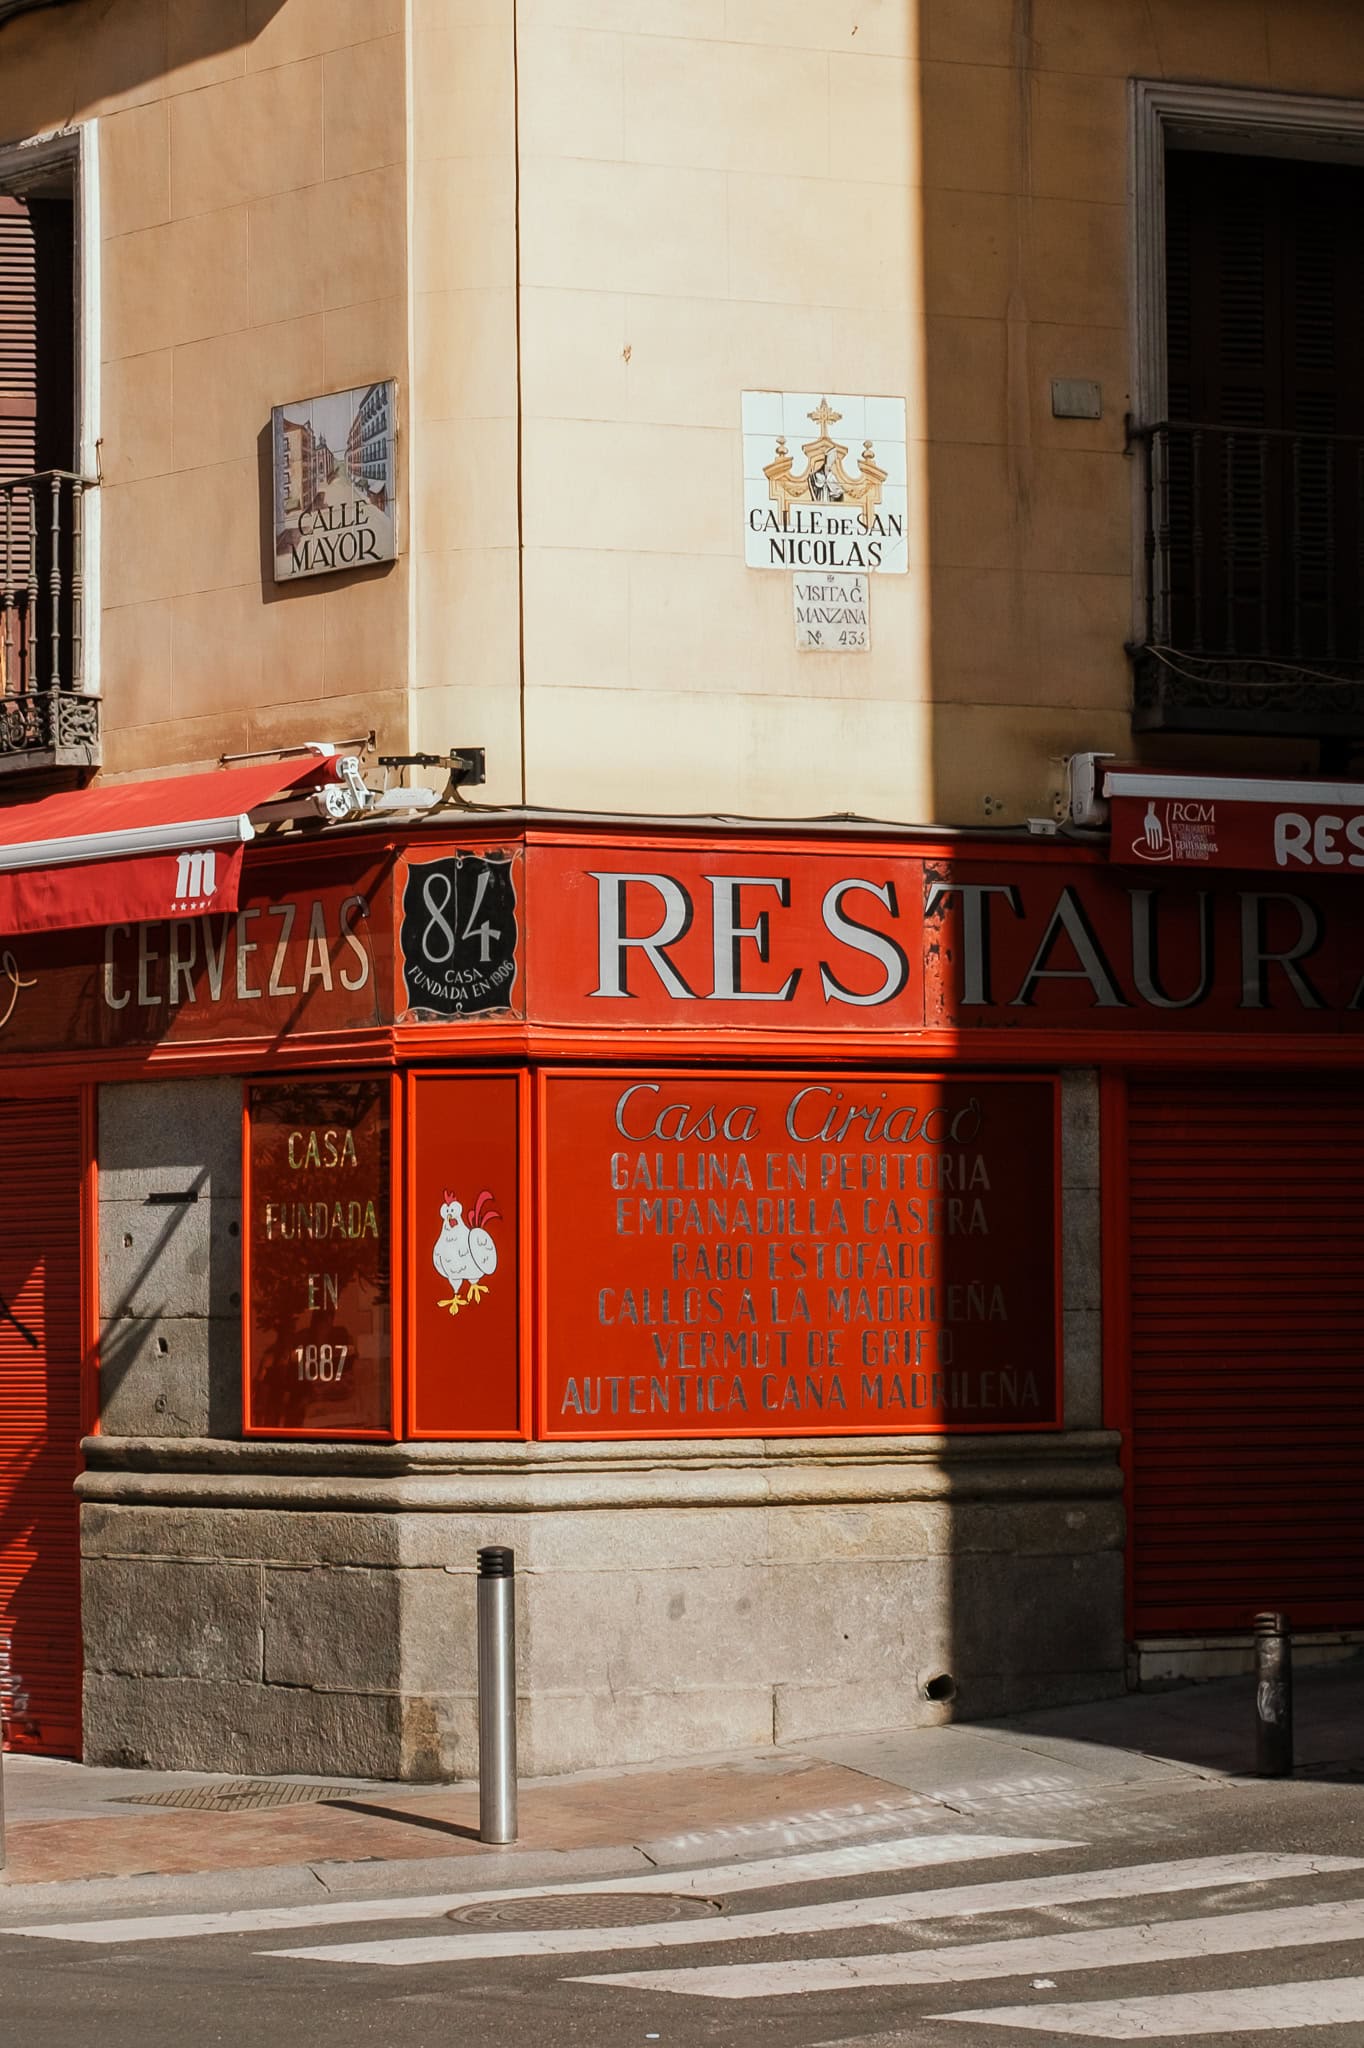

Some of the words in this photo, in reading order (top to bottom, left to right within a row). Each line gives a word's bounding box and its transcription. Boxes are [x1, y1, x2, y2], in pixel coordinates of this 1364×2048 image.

[298, 499, 370, 537] CALLE
[749, 508, 823, 535] CALLE
[827, 517, 853, 536] DE
[856, 512, 903, 537] SAN
[290, 528, 384, 574] MAYOR
[768, 537, 883, 567] NICOLAS
[795, 584, 848, 603] VISITA
[796, 607, 867, 625] MANZANA
[1172, 802, 1216, 822] RCM
[422, 870, 502, 963] 84
[103, 895, 370, 1010] CERVEZAS
[583, 870, 1364, 1010] RESTAUR
[407, 964, 469, 1000] FUNDADA
[471, 982, 491, 998] EN
[444, 967, 484, 985] CASA
[615, 1083, 760, 1142] Casa
[785, 1085, 982, 1144] Ciriaco
[287, 1129, 358, 1170] CASA
[610, 1152, 754, 1191] GALLINA
[766, 1152, 807, 1191] EN
[821, 1152, 991, 1191] PEPITORIA
[265, 1200, 379, 1240] FUNDADA
[616, 1197, 848, 1235] EMPANADILLA
[863, 1197, 989, 1235] CASERA
[671, 1242, 753, 1280] RABO
[768, 1242, 936, 1280] ESTOFADO
[308, 1272, 339, 1311] EN
[598, 1287, 725, 1326] CALLOS
[737, 1287, 758, 1324] A
[771, 1287, 812, 1324] LA
[827, 1280, 1009, 1323] MADRILEÑA
[295, 1343, 348, 1382] 1887
[652, 1330, 793, 1369] VERMUT
[807, 1330, 845, 1367] DE
[861, 1329, 954, 1367] GRIFO
[561, 1374, 749, 1415] AUTENTICA
[860, 1365, 1041, 1410] MADRILEÑA
